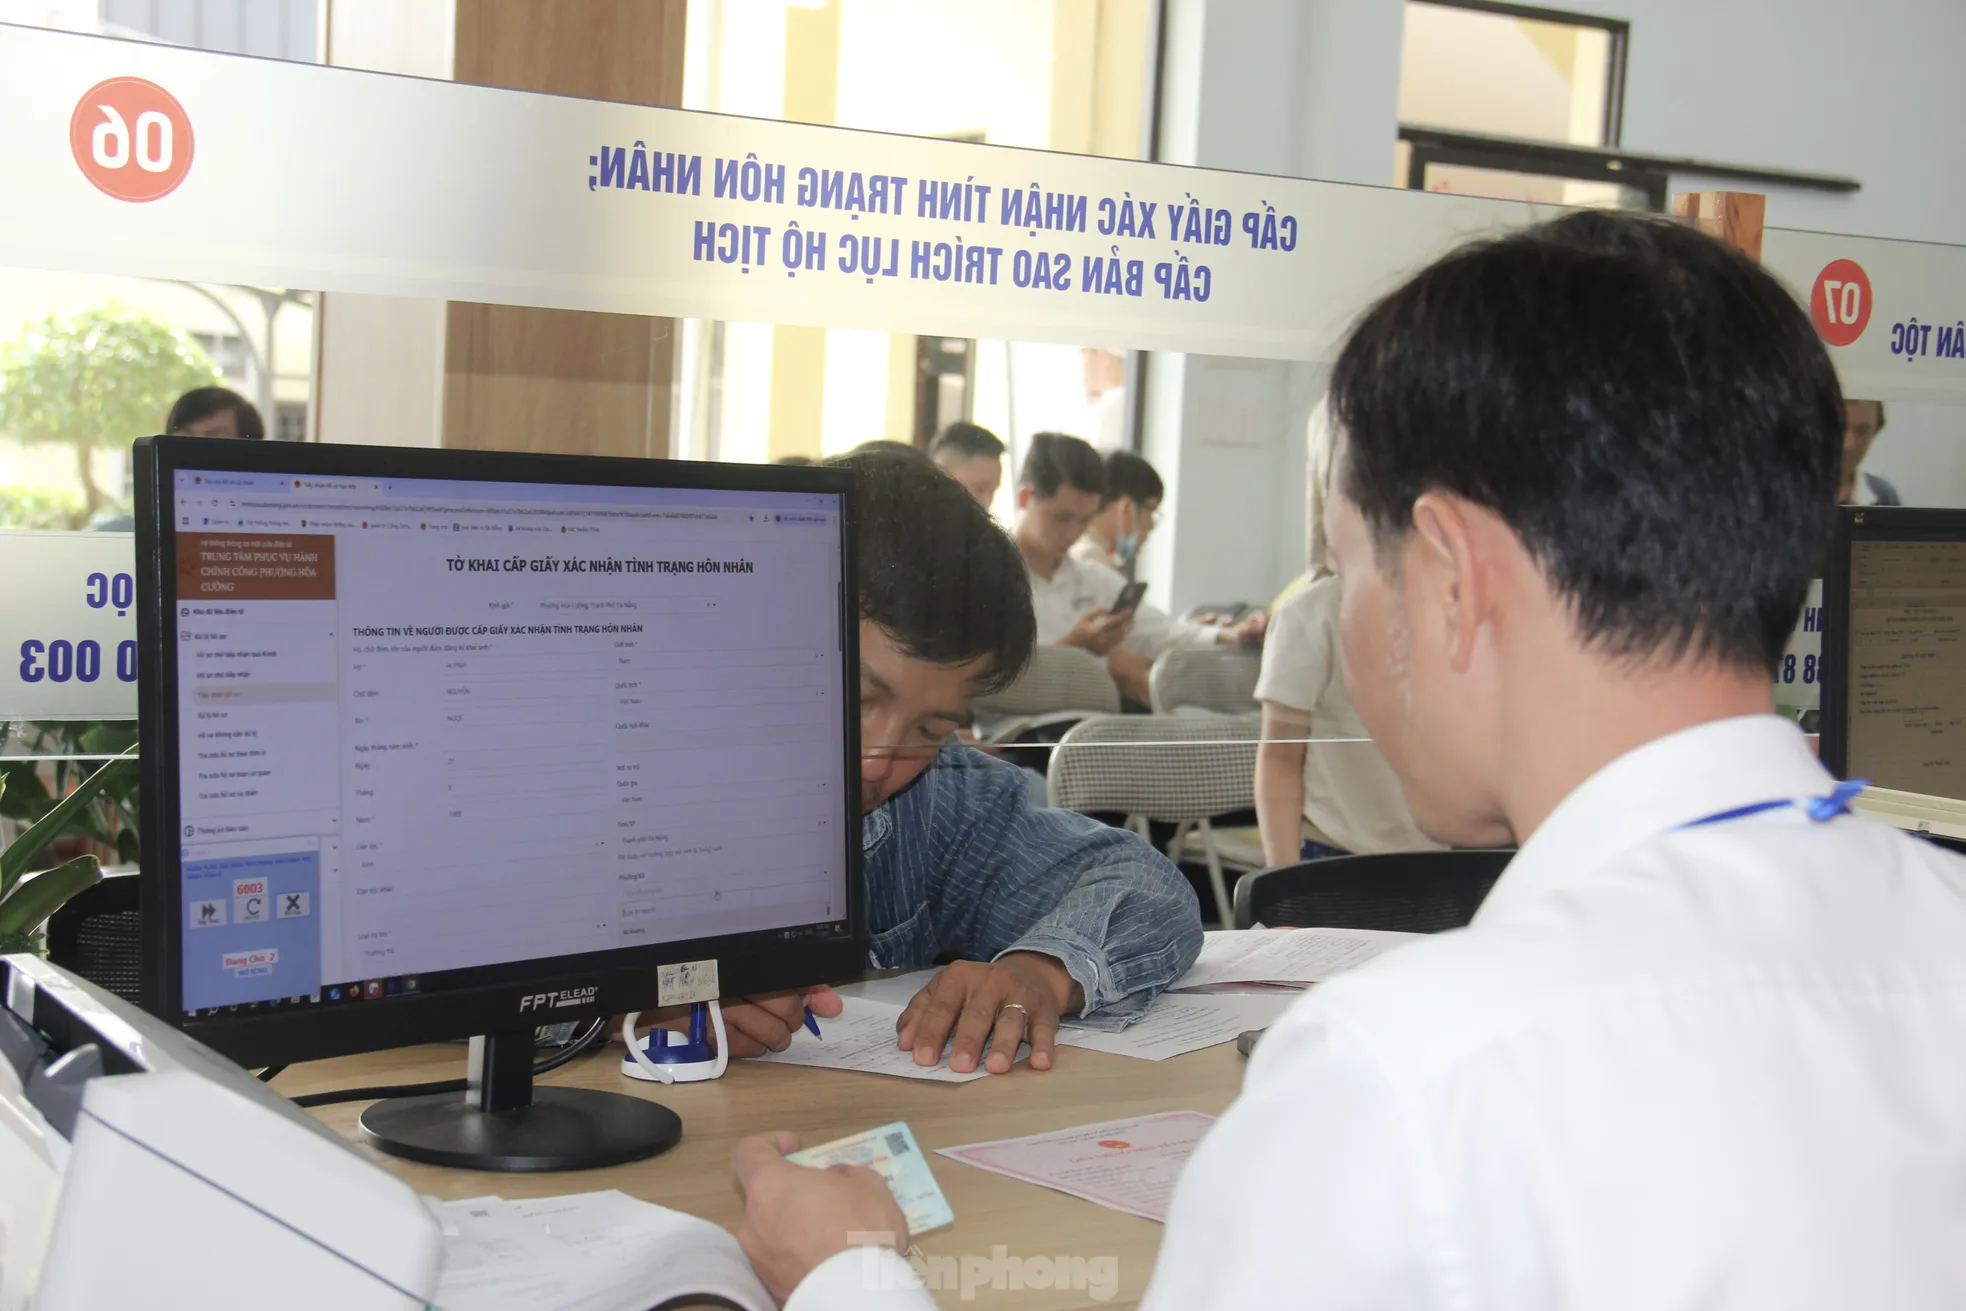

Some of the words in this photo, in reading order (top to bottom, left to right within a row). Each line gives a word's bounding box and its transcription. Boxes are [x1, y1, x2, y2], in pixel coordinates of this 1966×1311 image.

[447, 555, 464, 572] TỜ
[469, 560, 499, 572] KHAI
[503, 556, 526, 572] CẤP
[530, 556, 559, 572] GIẤY
[563, 557, 586, 572] XÁC
[589, 557, 622, 576] NHẬN
[626, 557, 653, 573] TÌNH
[657, 561, 694, 575] TRẠNG
[697, 558, 720, 573] HÔN
[723, 558, 753, 573] NHÂN
[353, 626, 384, 636] THÔNG
[387, 628, 400, 636] TIN
[403, 625, 413, 636] VỀ
[416, 627, 444, 636] NGƯỜI
[446, 627, 470, 638] ĐƯỢC
[472, 625, 488, 635] CẤP
[489, 624, 508, 635] GIẤY
[510, 625, 526, 634] XÁC
[528, 624, 551, 635] NHẬN
[554, 624, 572, 634] TÌNH
[575, 625, 600, 635] TRẠNG
[602, 623, 619, 633] HÔN
[621, 623, 643, 632] NHÂN
[237, 883, 263, 895] 6003
[270, 953, 275, 961] 2
[519, 991, 559, 1013] FPT
[560, 986, 596, 1000] ELEAD
